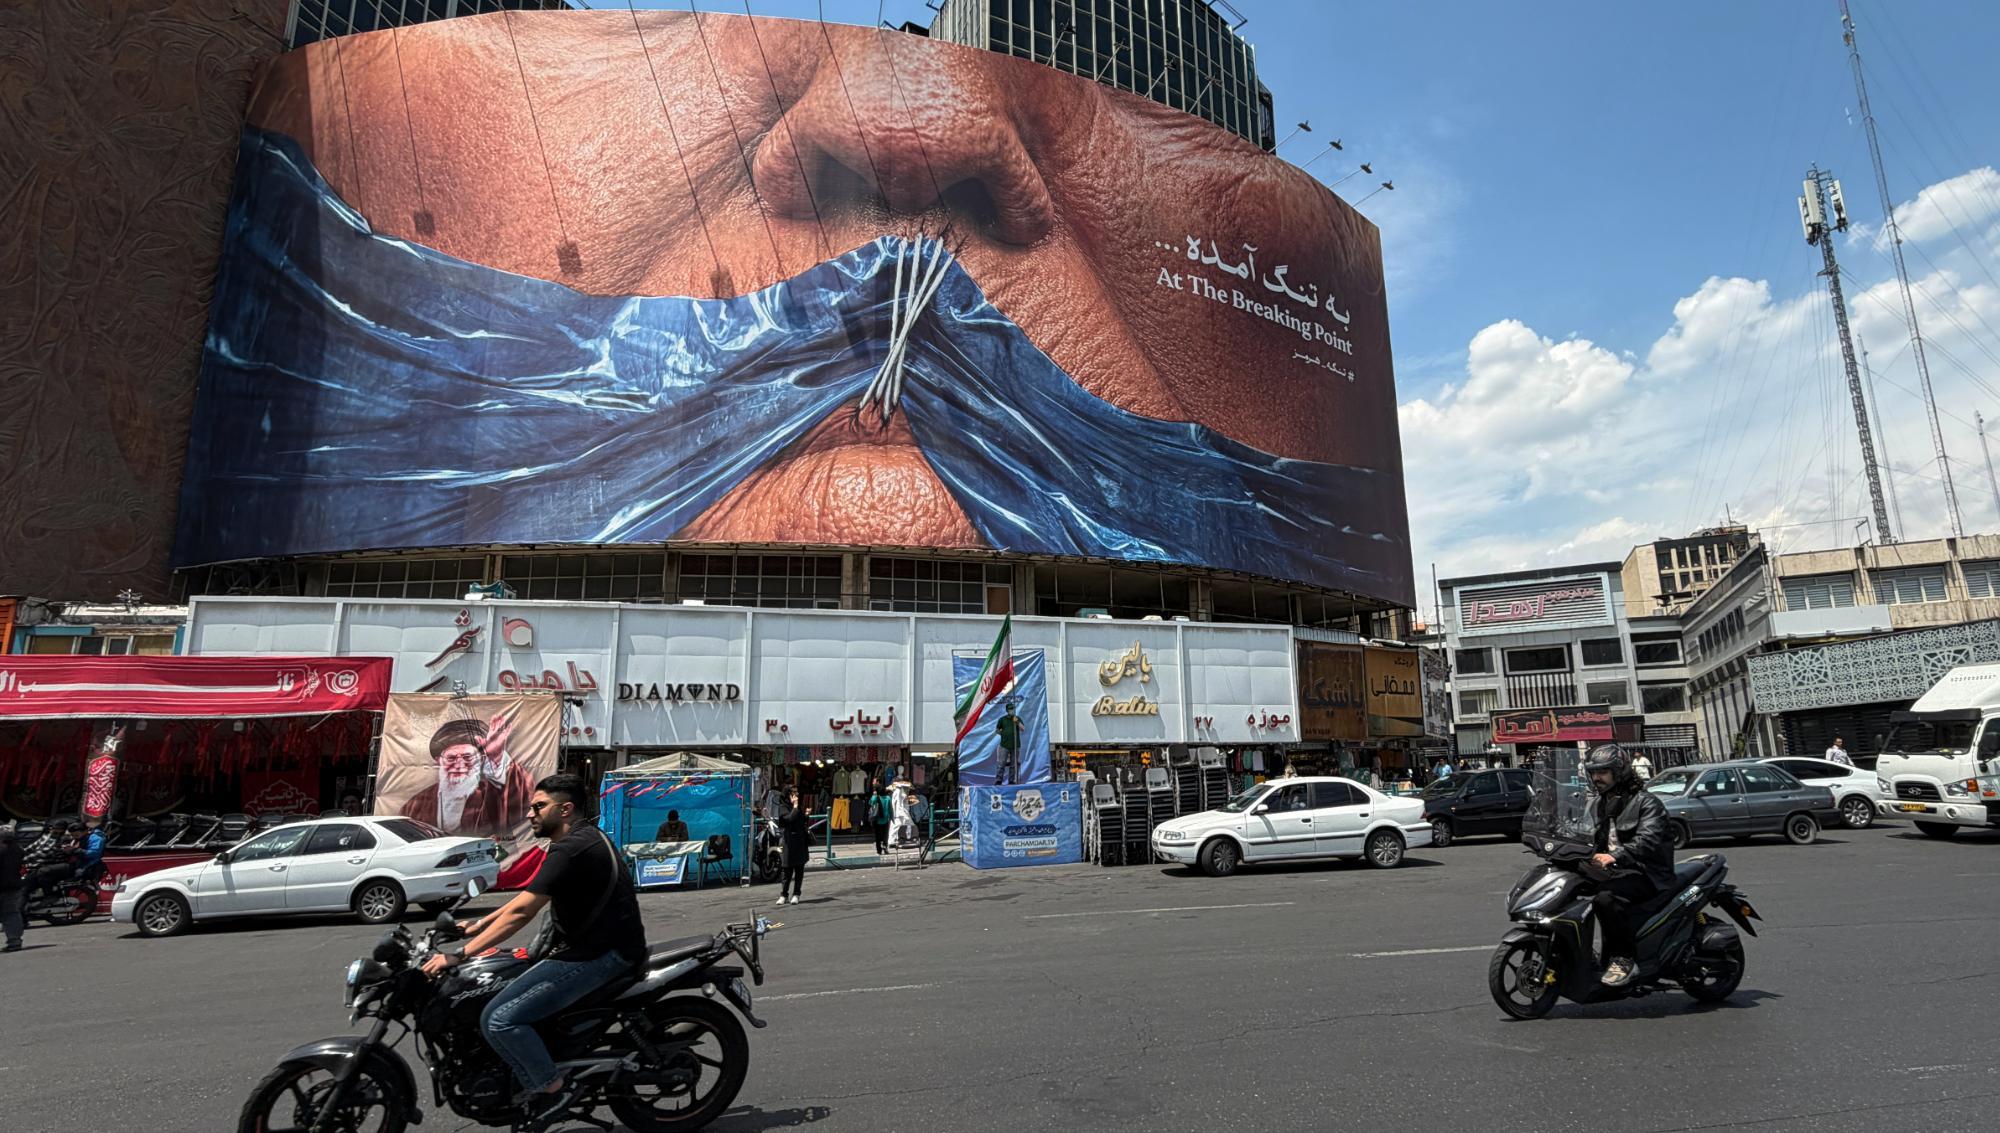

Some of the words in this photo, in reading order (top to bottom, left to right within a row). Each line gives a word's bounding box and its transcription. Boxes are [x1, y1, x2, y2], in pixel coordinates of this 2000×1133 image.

[1263, 265, 1318, 308] تنگ
[1156, 267, 1184, 290] At
[1187, 274, 1229, 304] The
[1232, 289, 1312, 342] Breaking
[1314, 322, 1353, 356] Point
[1325, 294, 1350, 332] به
[1099, 639, 1153, 687] بالین
[828, 706, 895, 735] زیبایی
[1091, 695, 1159, 717] Balin
